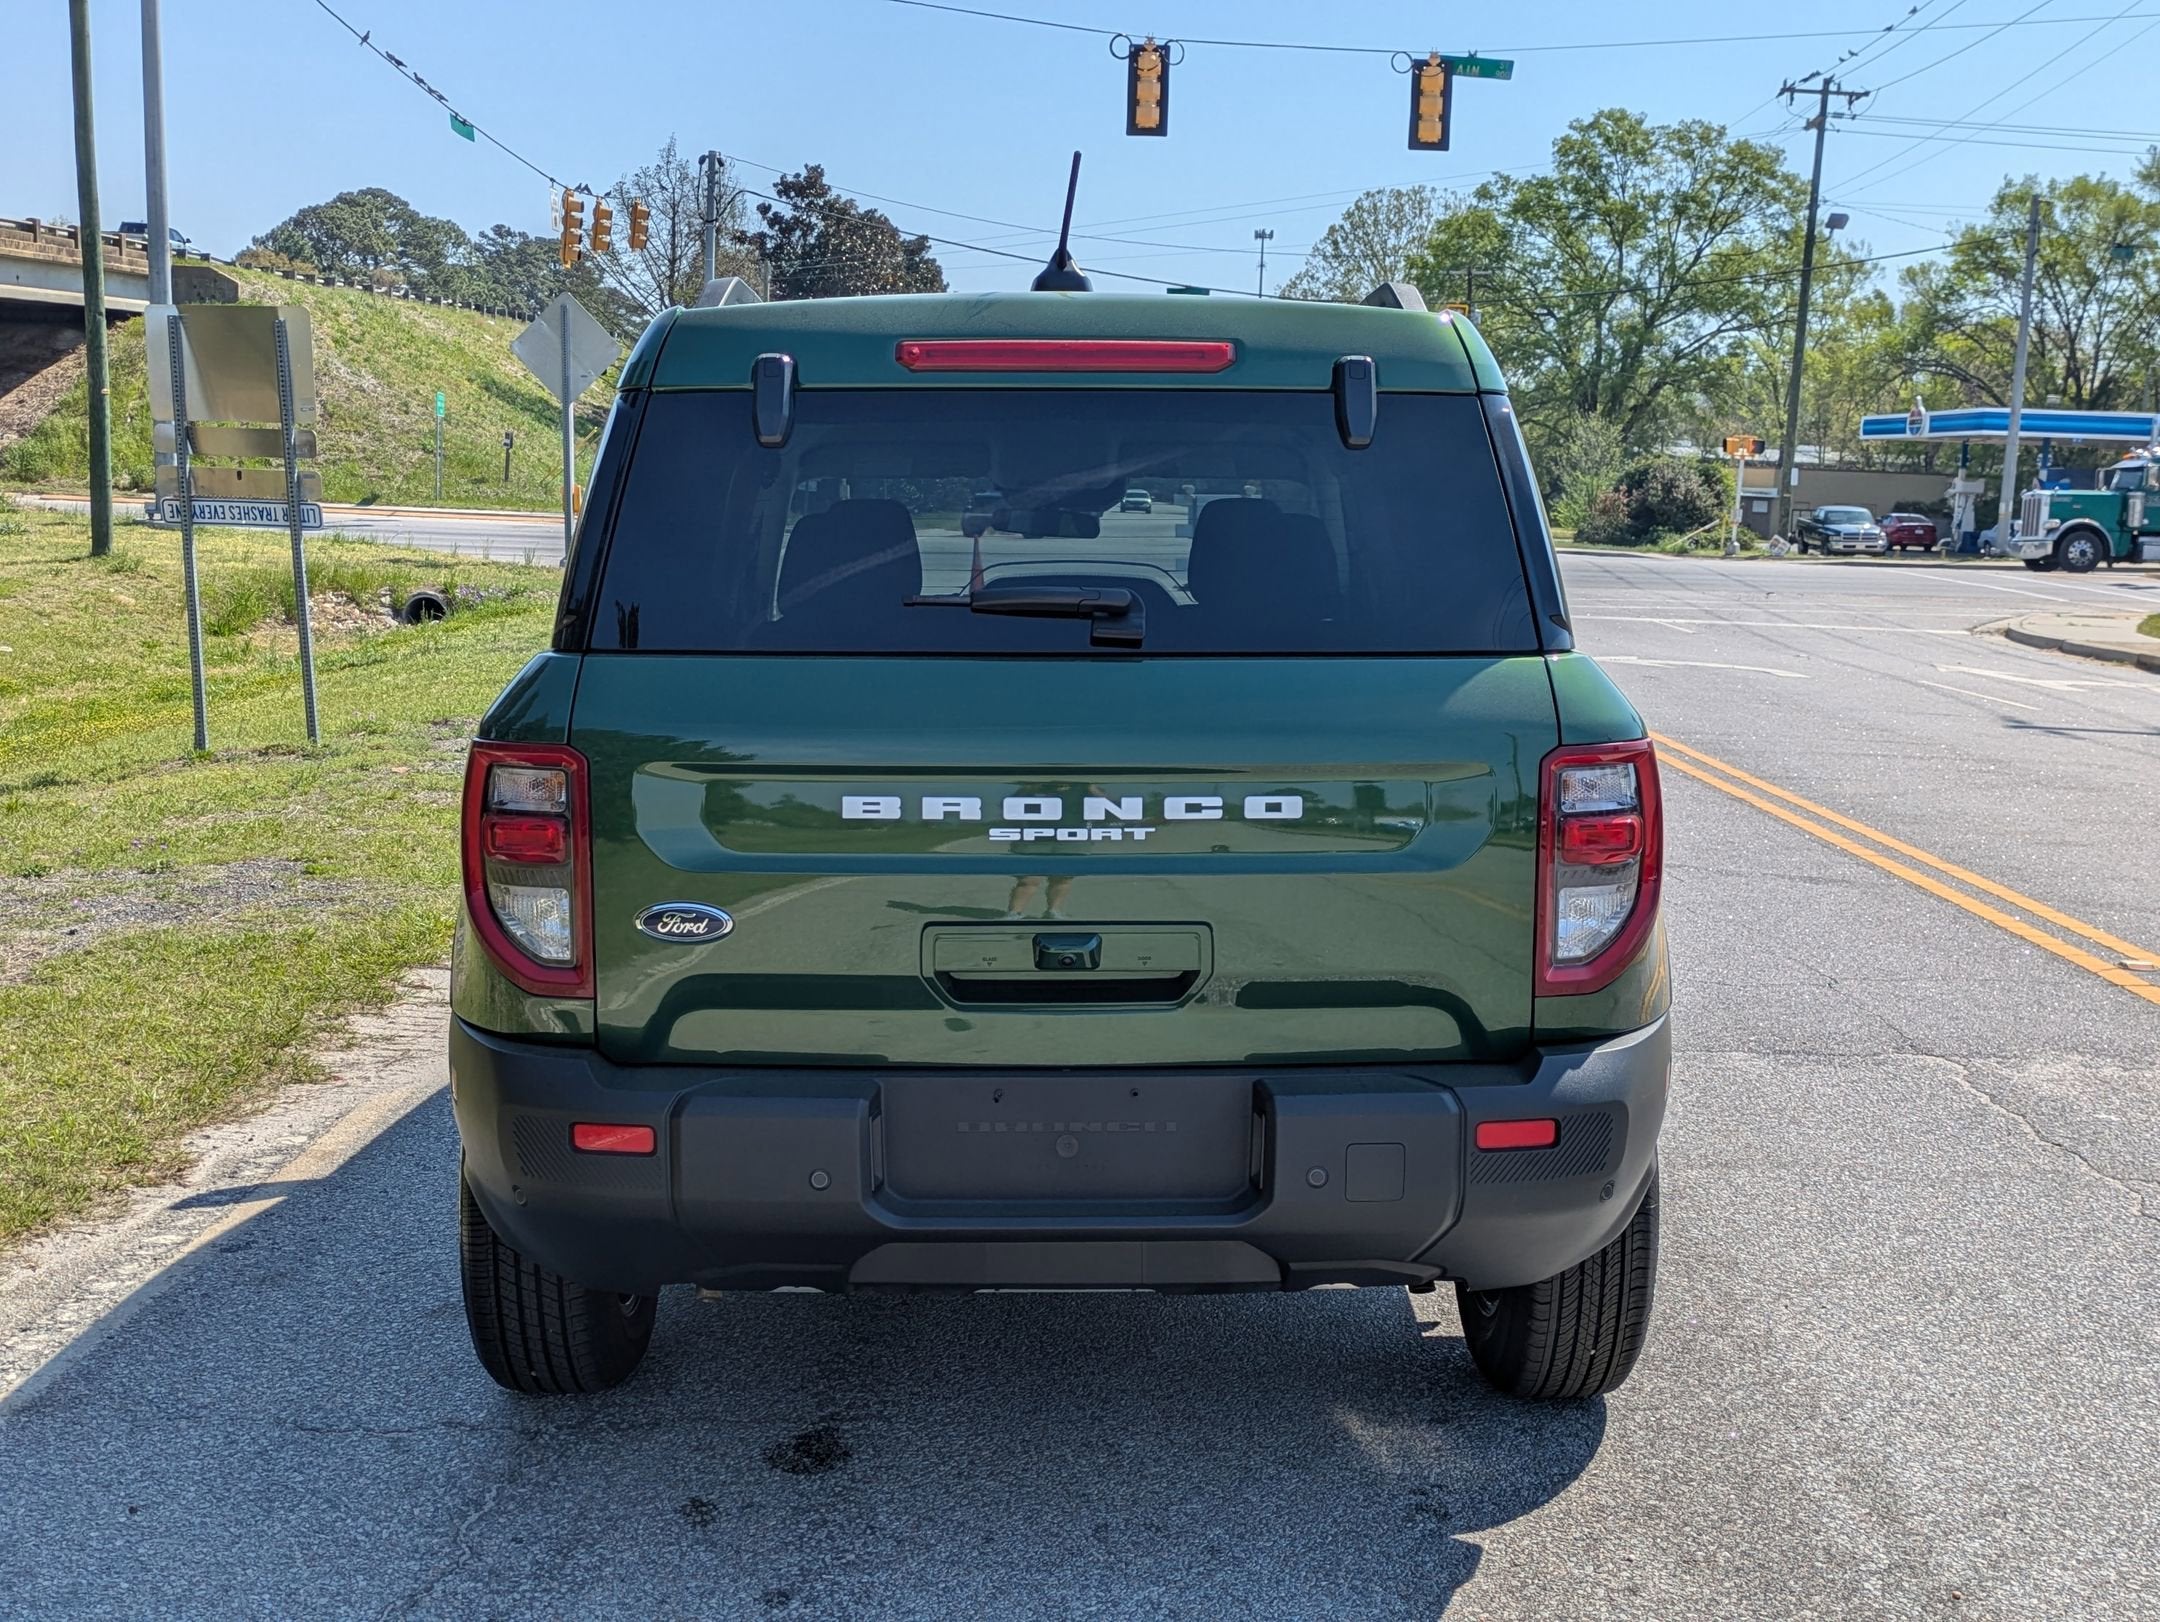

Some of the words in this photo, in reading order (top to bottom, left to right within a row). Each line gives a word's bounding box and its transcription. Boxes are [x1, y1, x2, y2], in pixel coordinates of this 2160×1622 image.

[167, 503, 226, 520] EVERYNE
[228, 504, 279, 522] TRASHES
[281, 506, 317, 524] LITR
[841, 795, 1304, 821] BRONCO
[988, 827, 1156, 842] SPORT
[657, 911, 709, 934] Ford
